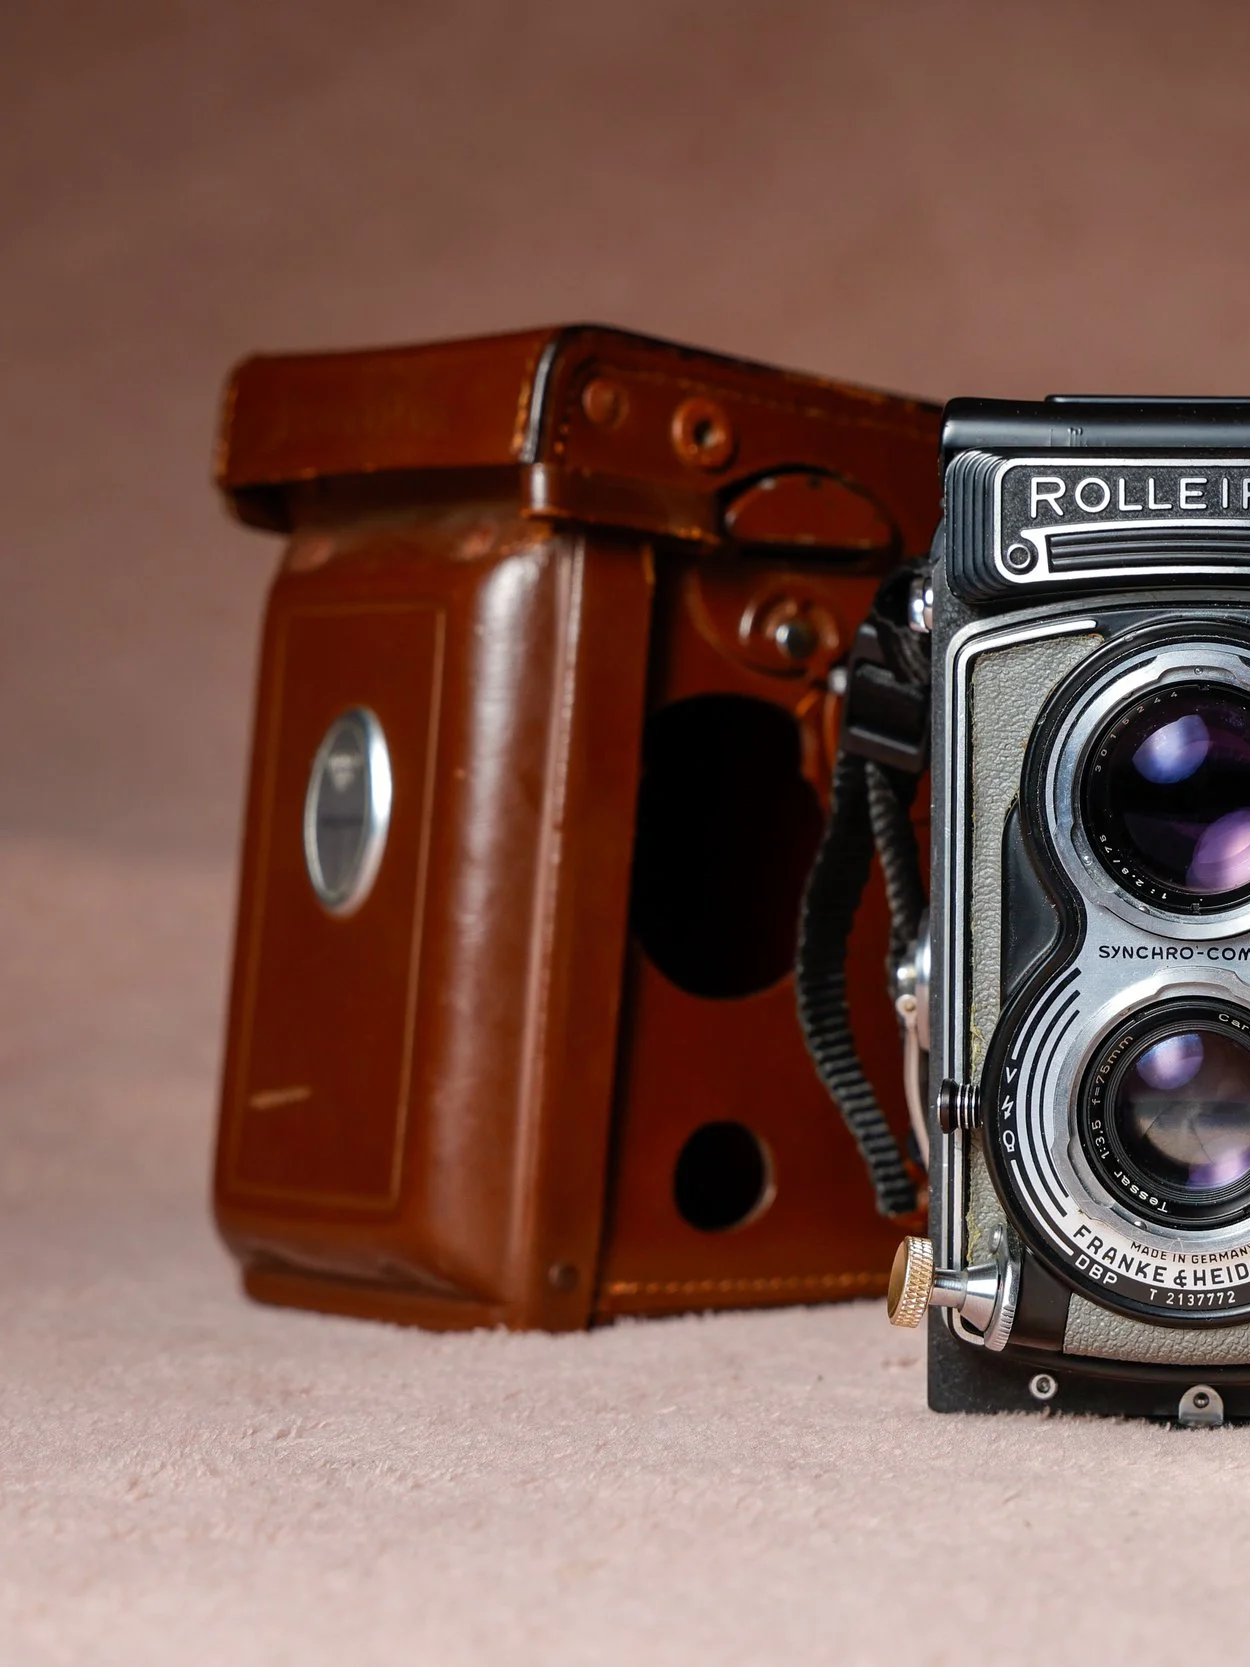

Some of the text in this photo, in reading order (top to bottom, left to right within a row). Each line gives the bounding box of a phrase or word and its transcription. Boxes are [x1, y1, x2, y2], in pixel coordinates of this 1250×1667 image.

[1006, 1066, 1018, 1084] V
[1091, 1035, 1168, 1213] Tessar 1:3.5 f=75mm
[1073, 1224, 1167, 1284] FRANKE
[1173, 1269, 1187, 1288] &
[1131, 1241, 1168, 1261] MADE
[1172, 1254, 1186, 1264] IN
[1075, 1254, 1118, 1286] DBP
[1150, 1288, 1236, 1306] T 2137772
